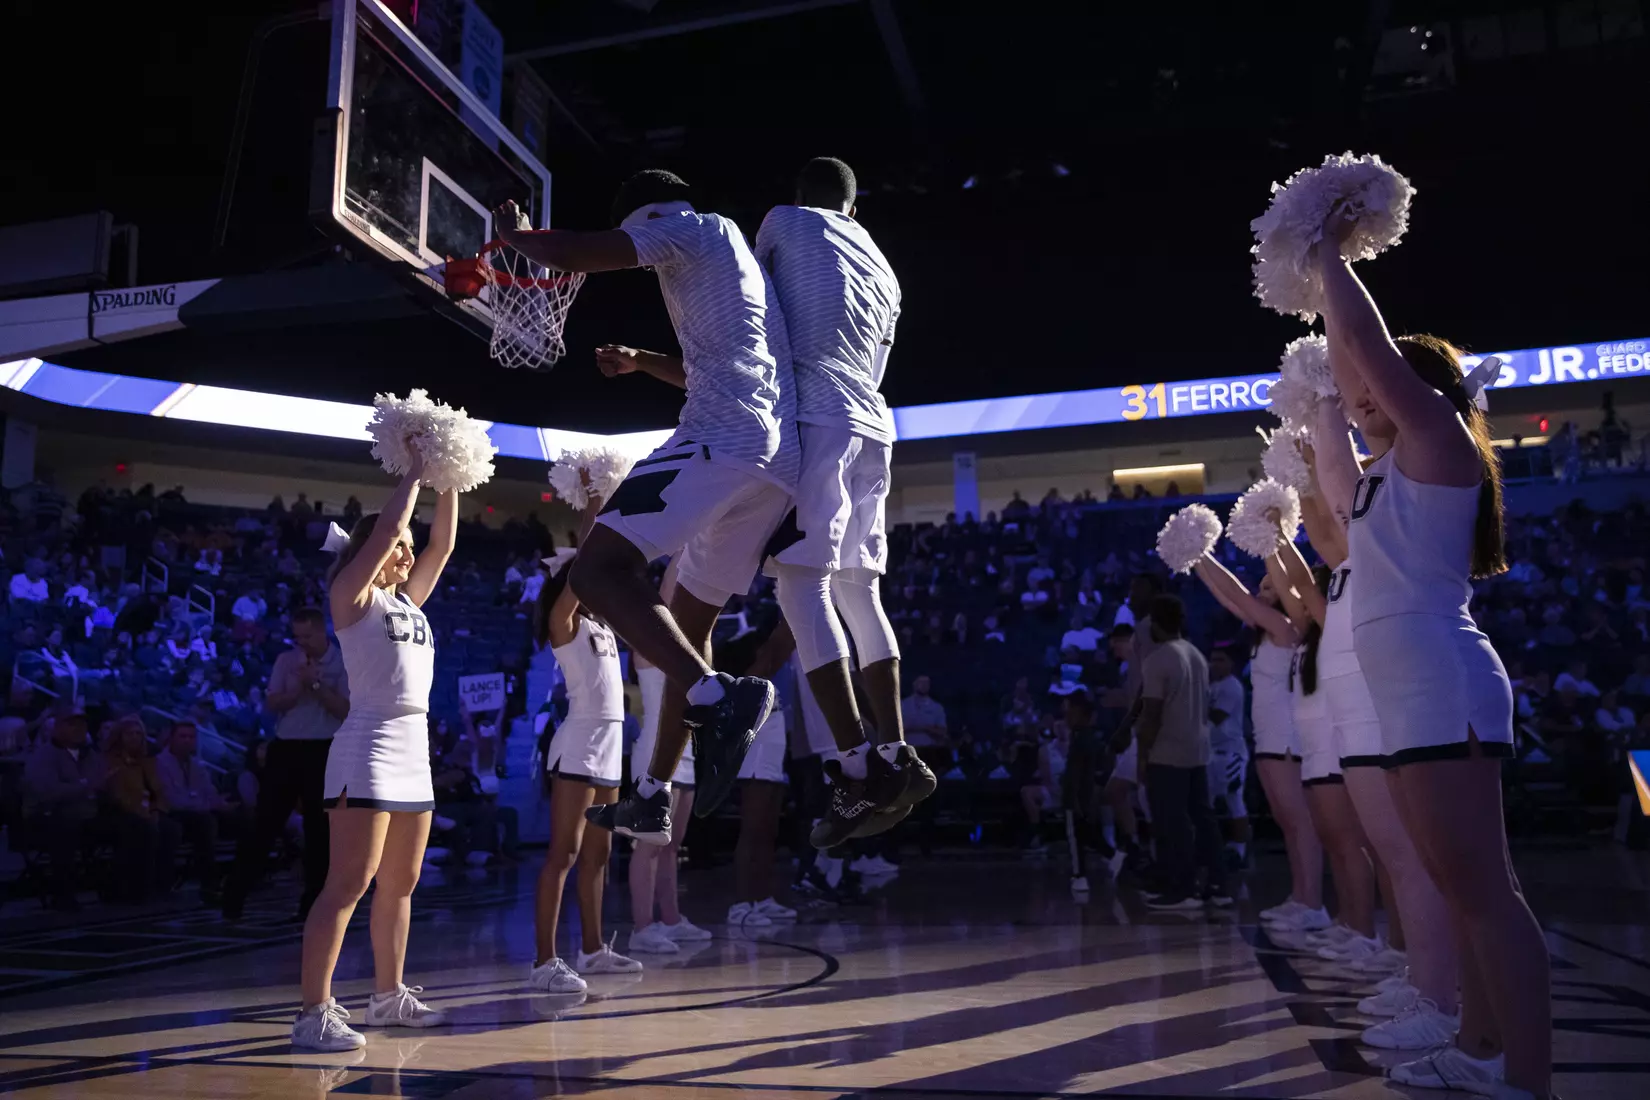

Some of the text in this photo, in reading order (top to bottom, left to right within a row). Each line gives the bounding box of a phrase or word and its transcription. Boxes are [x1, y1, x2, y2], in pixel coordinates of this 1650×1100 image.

[91, 284, 176, 314] SPALDING
[1596, 341, 1646, 357] GUARD
[1120, 382, 1167, 421] 31
[1528, 347, 1599, 385] JR.
[462, 680, 501, 694] LANCE
